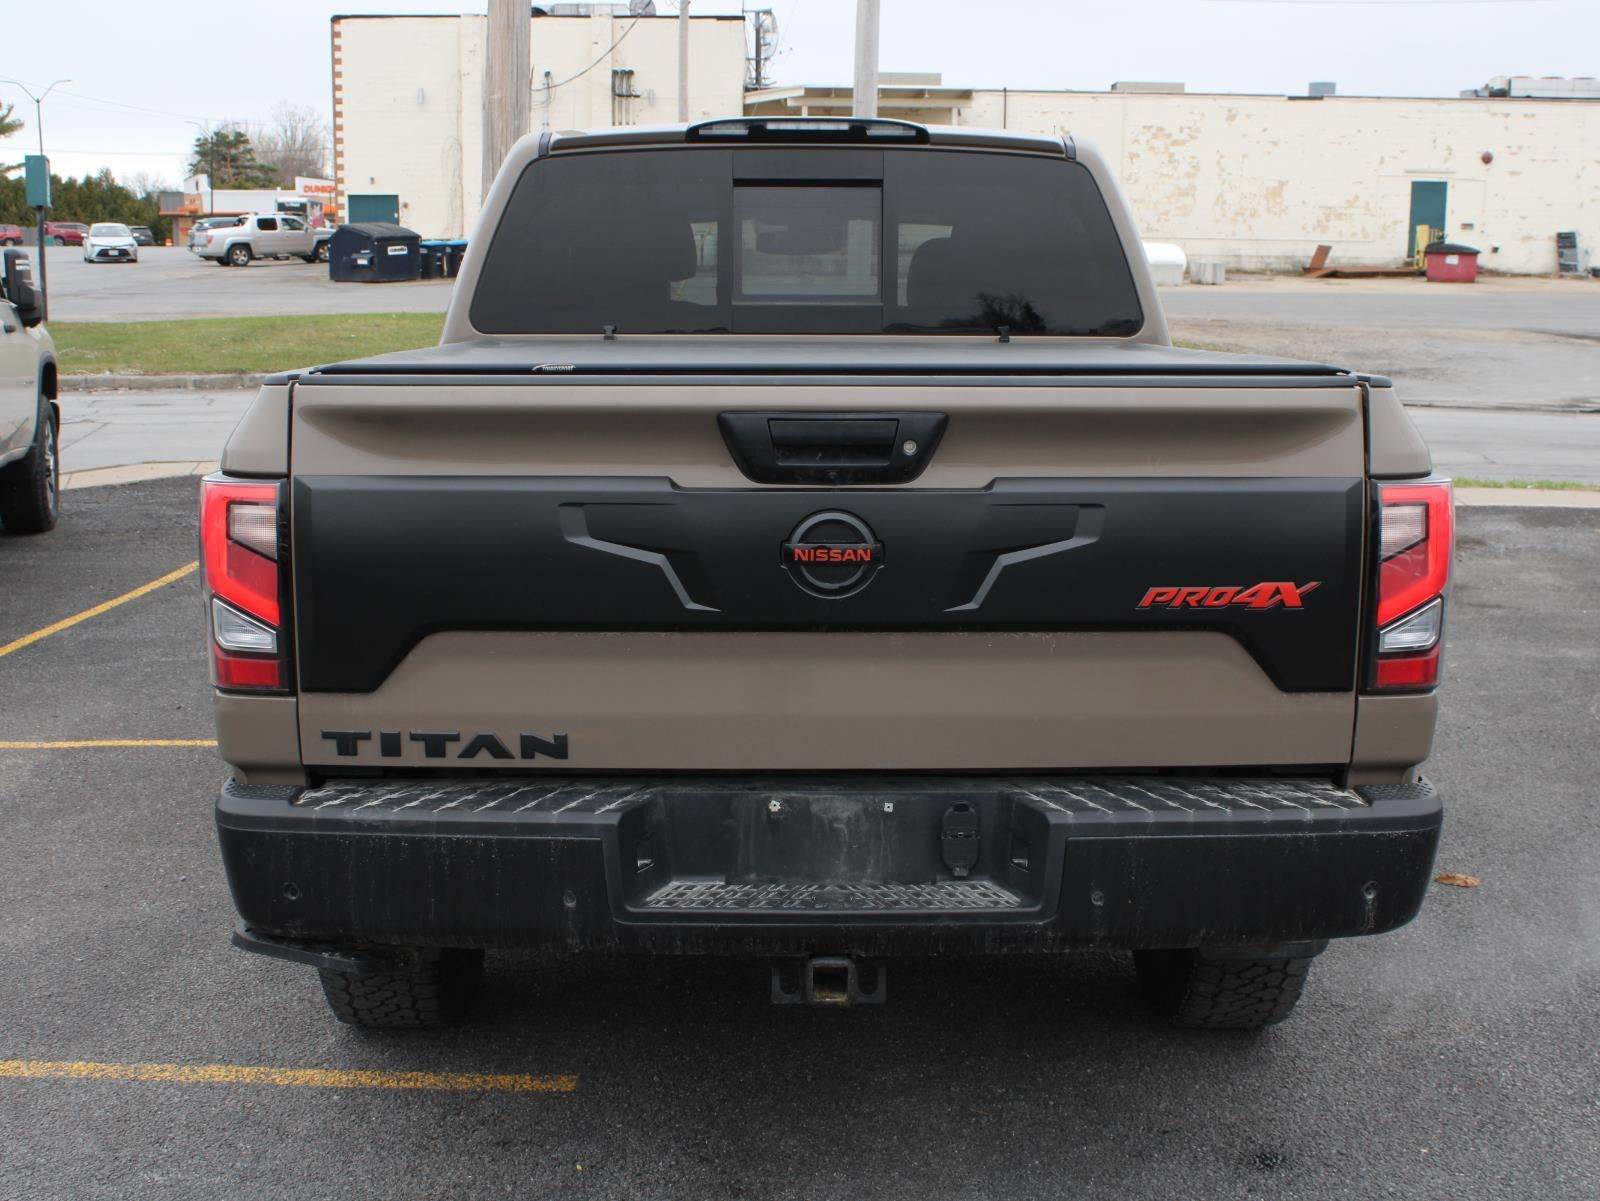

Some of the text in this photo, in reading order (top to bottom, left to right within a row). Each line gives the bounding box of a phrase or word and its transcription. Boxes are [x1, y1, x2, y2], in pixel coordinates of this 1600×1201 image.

[794, 548, 872, 562] NISSAN
[1137, 581, 1321, 610] PRO4X
[321, 730, 568, 760] TITAN
